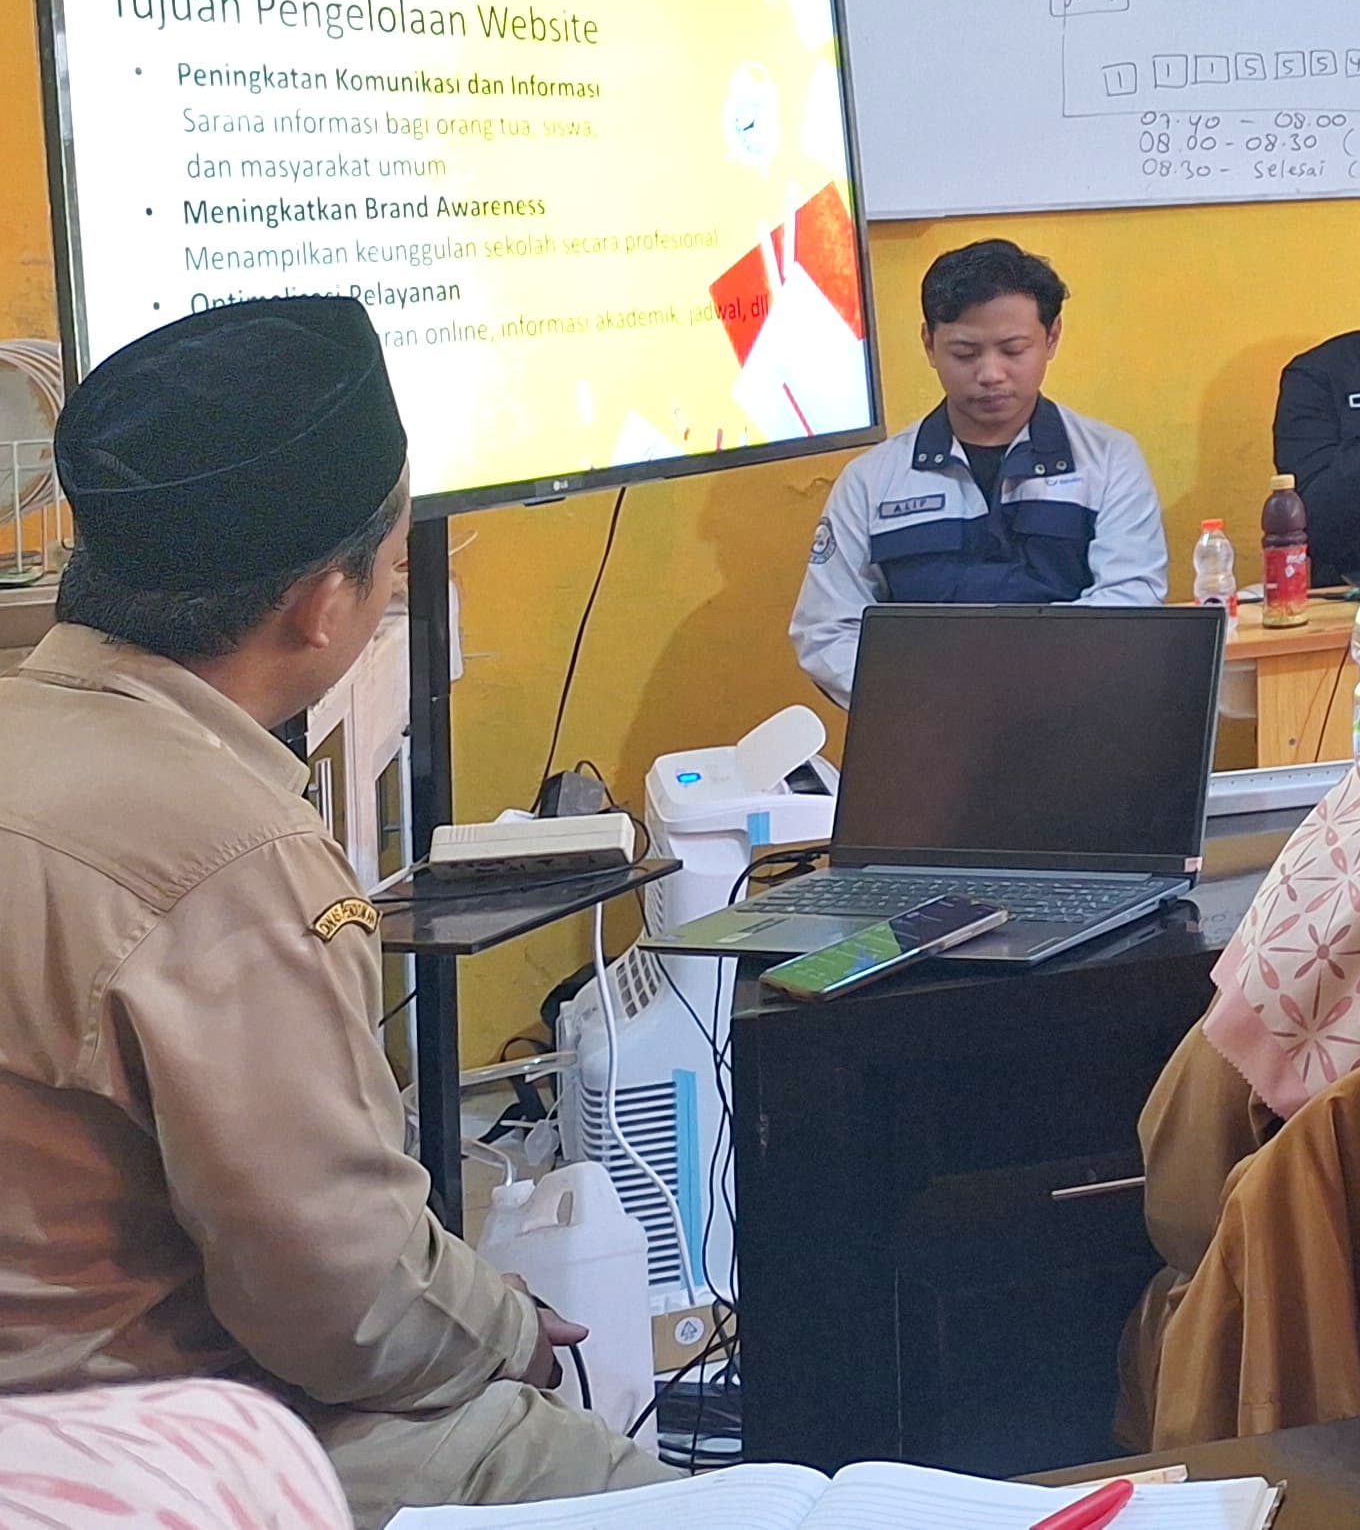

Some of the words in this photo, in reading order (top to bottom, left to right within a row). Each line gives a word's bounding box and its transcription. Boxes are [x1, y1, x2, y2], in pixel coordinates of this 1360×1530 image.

[477, 4, 598, 45] Website
[177, 62, 327, 95] Peningkatan
[336, 68, 460, 95] Komunikasi
[467, 72, 504, 96] dan
[511, 74, 600, 99] Informasi
[1244, 58, 1259, 76] 5
[1282, 59, 1295, 75] 5
[1316, 56, 1329, 72] 5
[183, 107, 265, 133] Sarana
[274, 108, 378, 135] informasi
[386, 110, 429, 141] bagi
[436, 117, 494, 142] orang
[1245, 132, 1317, 153] 08.30
[187, 152, 232, 179] dan
[241, 152, 371, 183] masyarakat
[378, 158, 447, 177] umum
[1253, 158, 1326, 179] Selesai
[183, 196, 357, 229] Meningkatkan
[365, 195, 429, 220] Brand
[436, 195, 546, 218] Awareness
[184, 240, 348, 273] Menampilkan
[355, 236, 477, 267] keunggulan
[484, 232, 556, 259] sekolah
[562, 233, 619, 255] secara
[625, 227, 720, 255] profesional
[350, 281, 461, 310] Pelayanan
[502, 313, 589, 339] informasi
[751, 293, 770, 318] dll
[892, 500, 928, 514] ALIF
